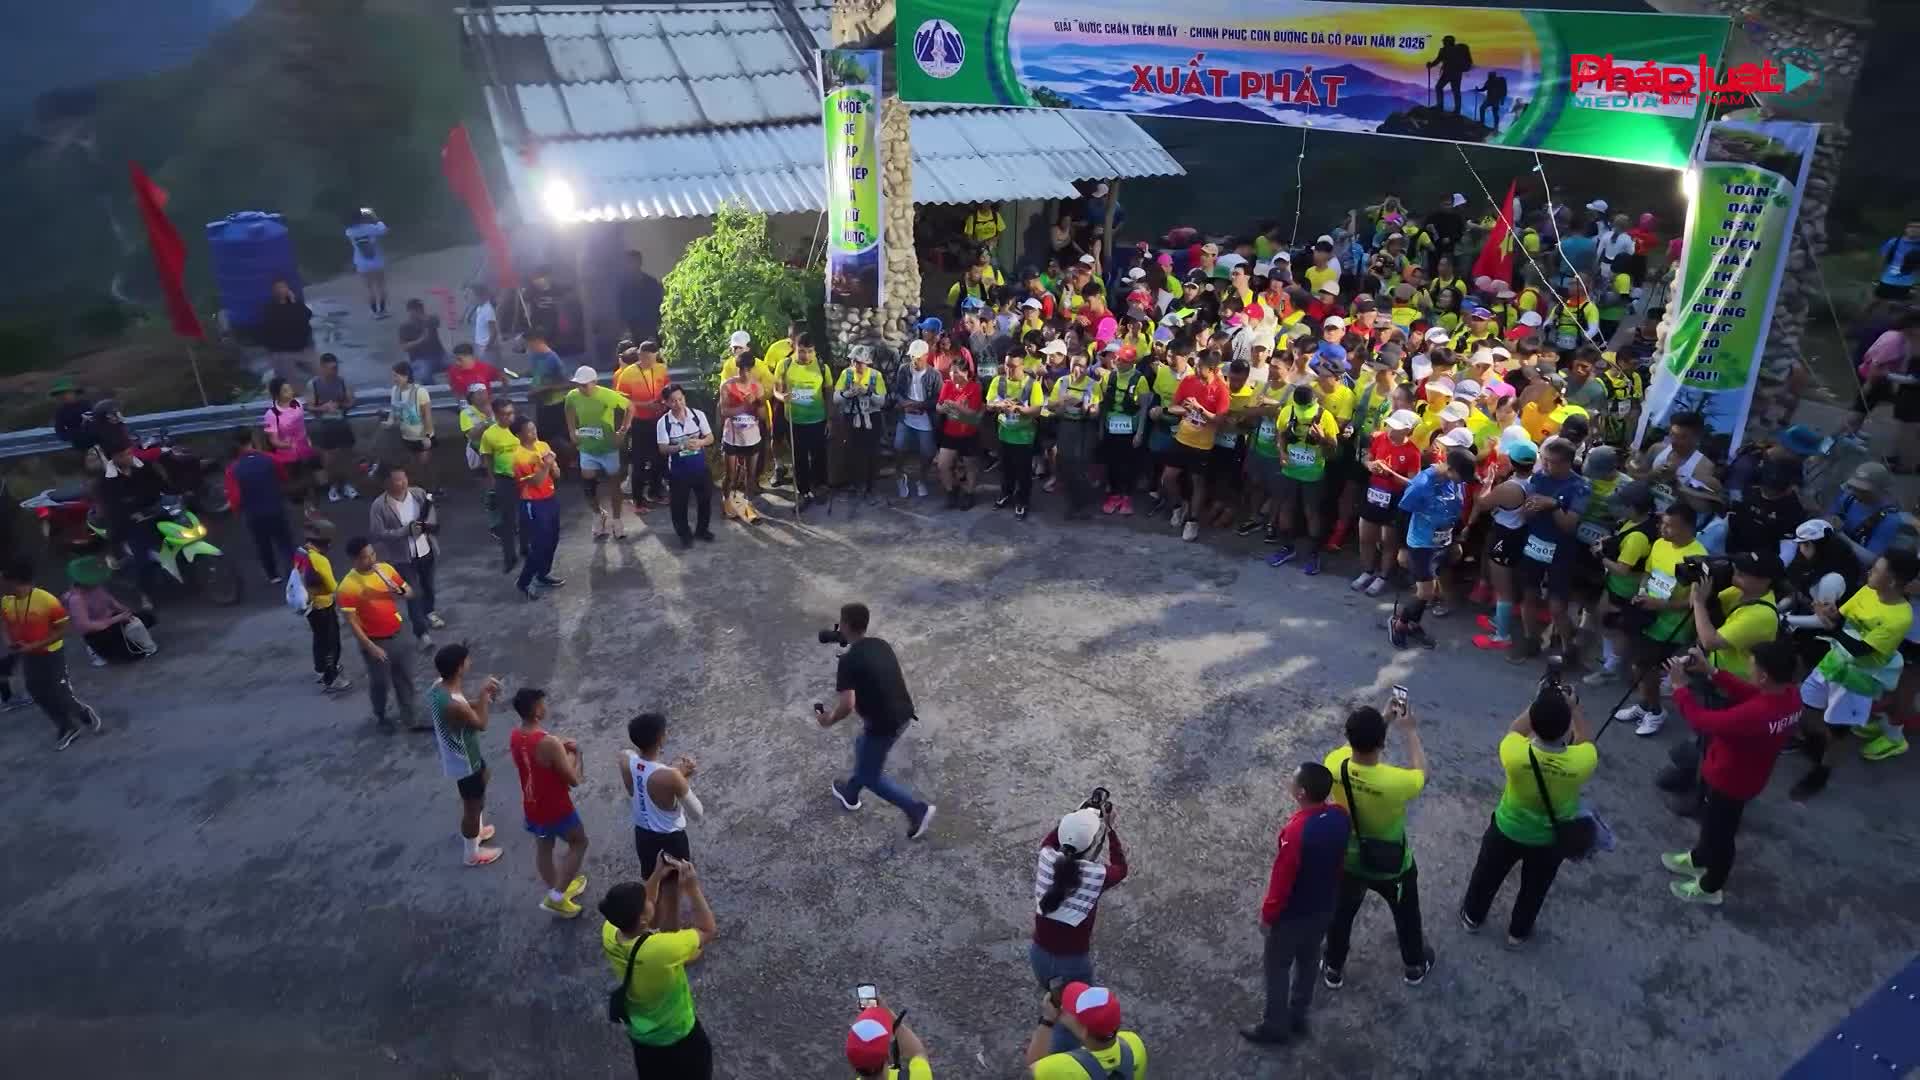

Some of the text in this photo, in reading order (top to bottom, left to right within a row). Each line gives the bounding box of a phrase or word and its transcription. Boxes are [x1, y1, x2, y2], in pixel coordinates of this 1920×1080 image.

[1345, 33, 1367, 46] PAVI
[1130, 52, 1347, 107] XUẤT PHÁT
